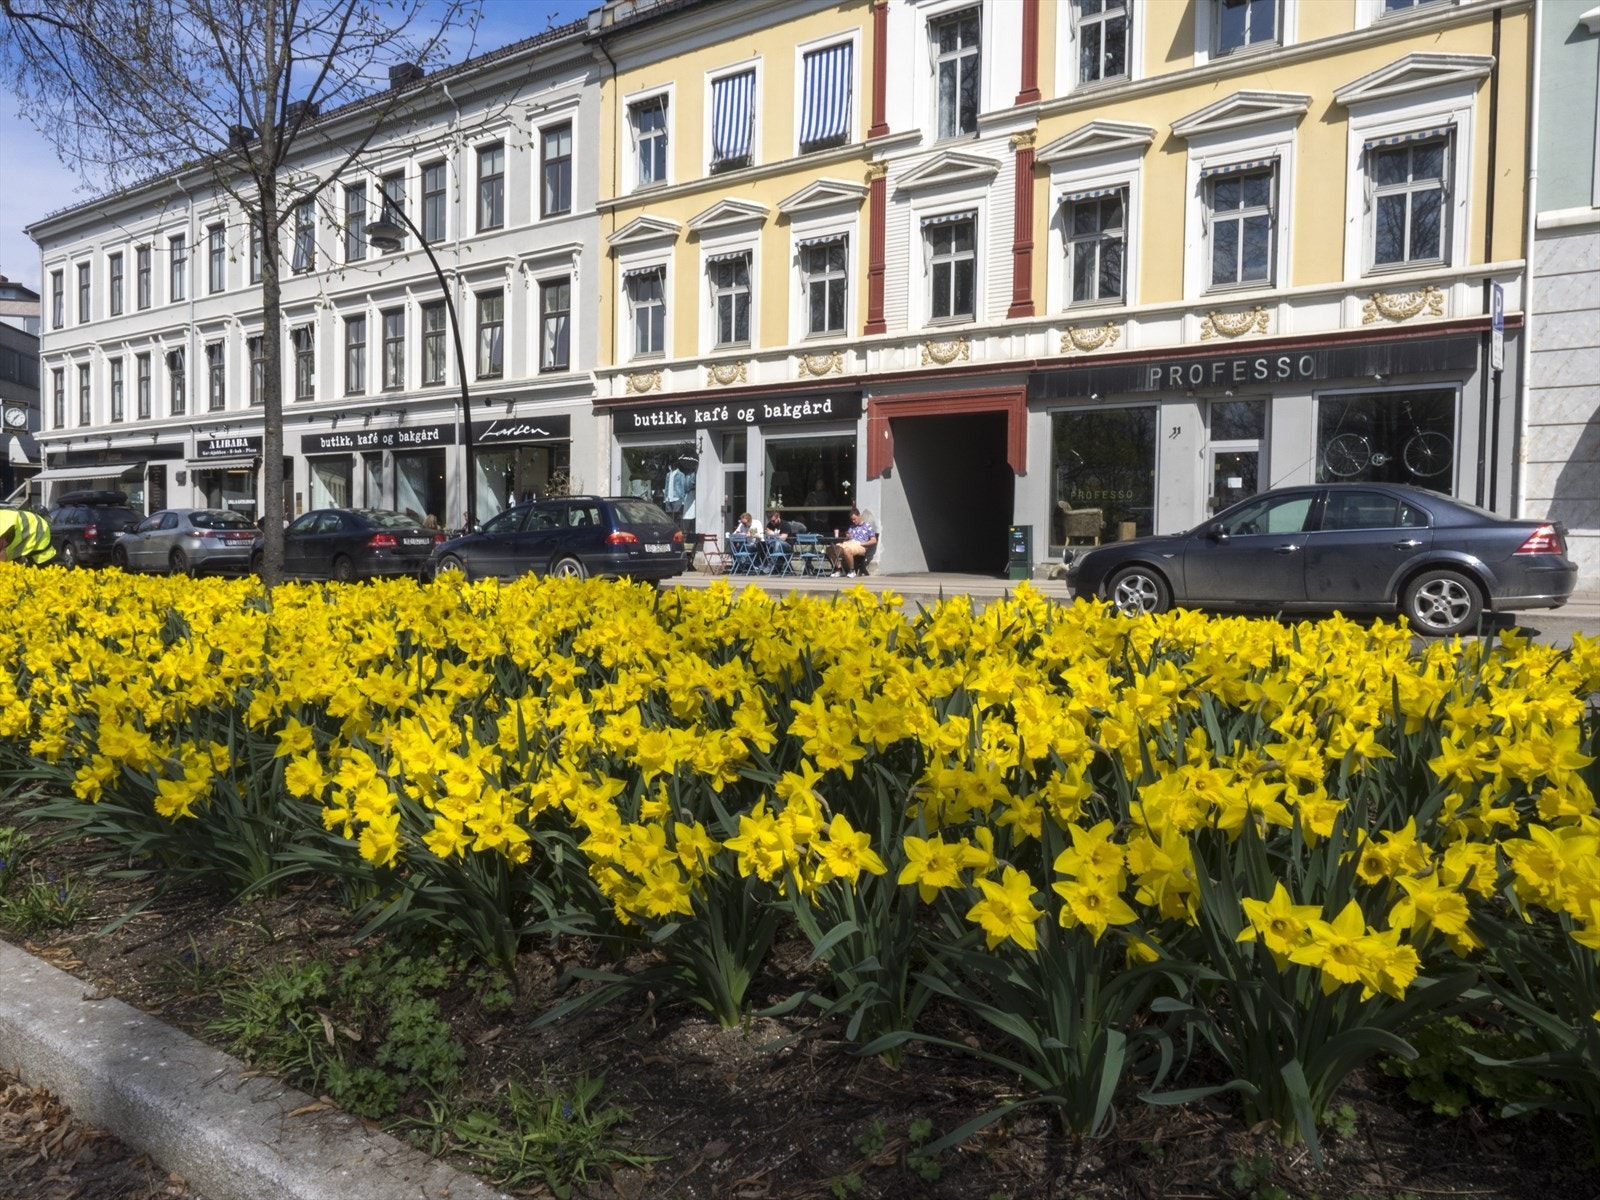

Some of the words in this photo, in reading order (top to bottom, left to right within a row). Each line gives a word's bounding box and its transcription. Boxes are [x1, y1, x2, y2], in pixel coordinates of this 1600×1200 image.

[1495, 290, 1502, 325] P
[1150, 355, 1315, 387] PROFESSO
[633, 411, 687, 427] butikk,
[695, 406, 729, 423] kafé
[737, 408, 755, 423] og
[764, 399, 833, 420] bakgård
[320, 436, 354, 448] butikk,
[357, 431, 378, 446] kafé
[383, 434, 394, 445] og
[398, 428, 440, 444] bakgård
[478, 420, 550, 441] Larsen
[209, 438, 248, 449] ALIBABA
[1070, 490, 1133, 500] PROFESSO
